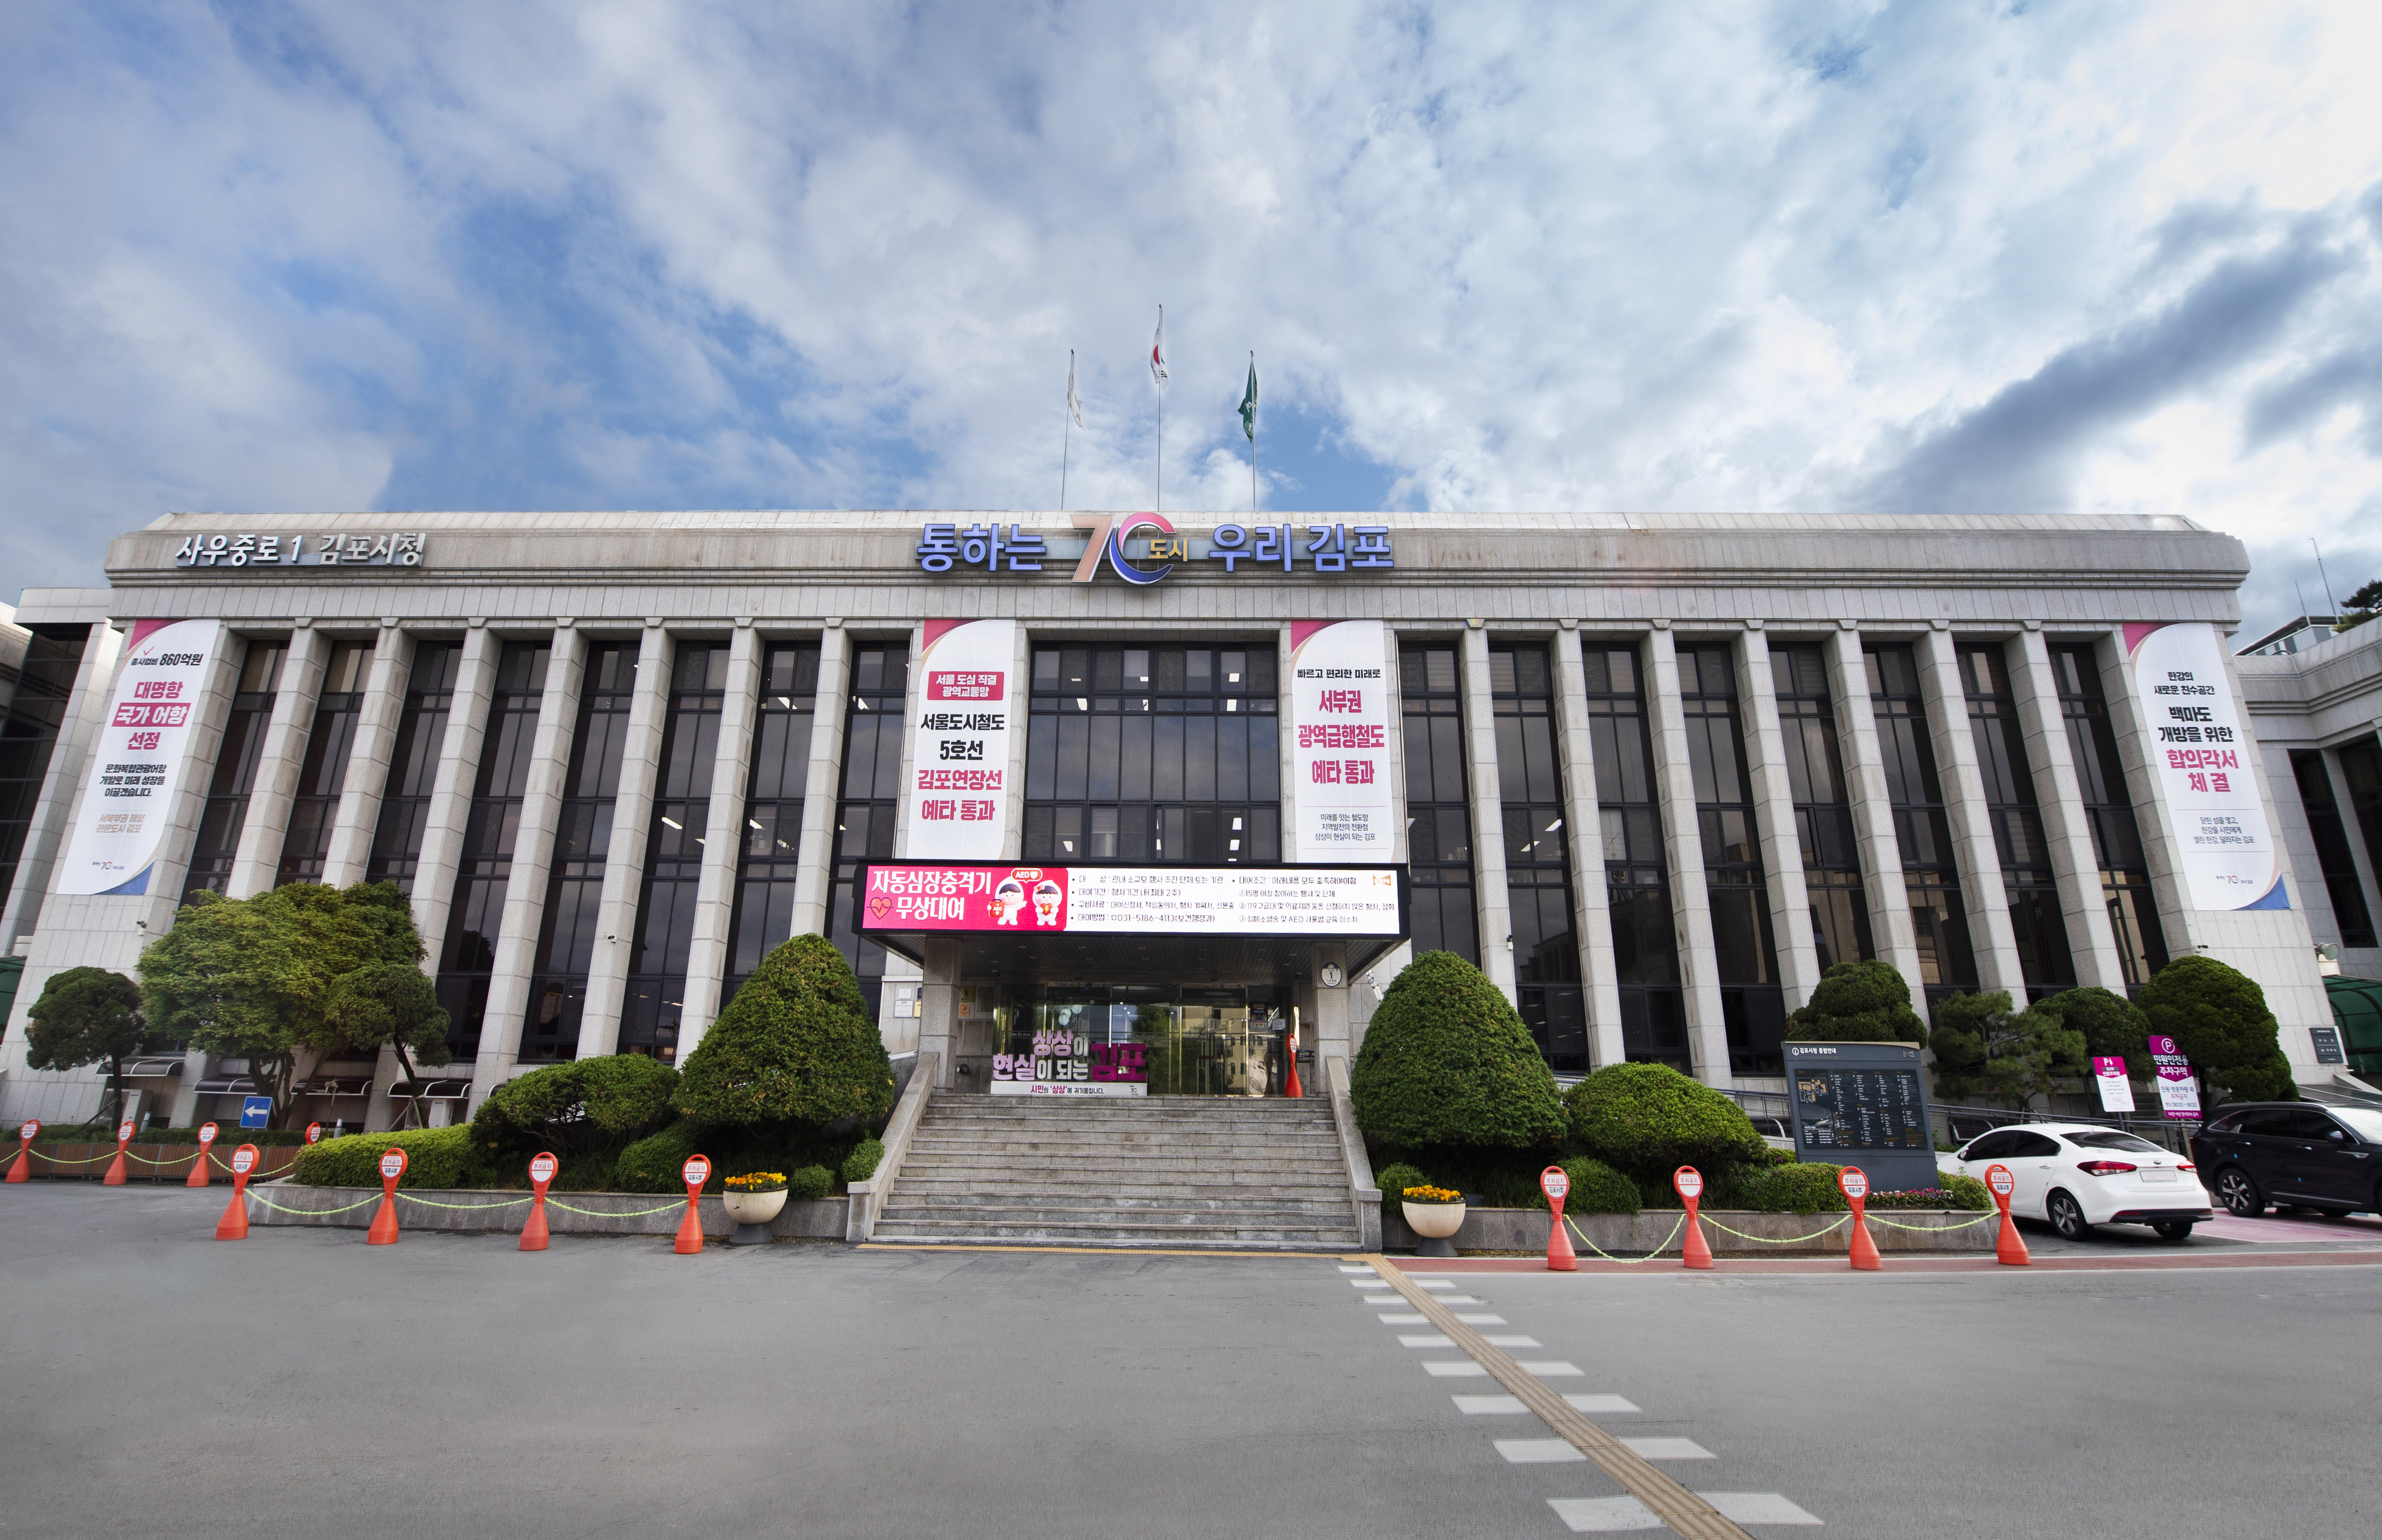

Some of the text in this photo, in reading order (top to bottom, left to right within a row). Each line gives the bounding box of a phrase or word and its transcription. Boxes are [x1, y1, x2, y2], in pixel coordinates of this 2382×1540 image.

[175, 532, 425, 566] 사우중로 1 김포시청
[917, 524, 1047, 572] 통하는
[1148, 539, 1188, 562] 도시
[1209, 524, 1292, 572] 우리
[1308, 524, 1394, 572] 김포
[159, 653, 203, 665] 860억원
[936, 675, 996, 685] 서울 도심 직결
[1298, 669, 1381, 679] 빠르고 편리한 미래로
[2167, 671, 2194, 681] 한강의
[134, 681, 183, 698] 대명항
[943, 686, 989, 697] 광역교통망
[2154, 685, 2215, 694] 새로운 친수공간
[1319, 690, 1362, 713] 서부권
[117, 706, 187, 724] 국가 어항
[921, 714, 1004, 730] 서울도시철도
[2169, 707, 2213, 722] 백마도
[128, 732, 161, 750] 선정
[1298, 725, 1385, 748] 광역급행철도
[2158, 726, 2234, 742] 개방을 위한
[940, 740, 983, 760] 5호선
[2166, 749, 2239, 769] 합의각서
[105, 764, 166, 773] 문화복합관광어항
[1311, 760, 1374, 784] 예타 통과
[100, 776, 165, 785] 개발로 미래 성장을
[918, 770, 1002, 790] 김포연장선
[105, 788, 152, 797] 이끌겠습니다.
[99, 814, 145, 823] 서북부권 해양
[922, 800, 995, 821] 예타 통과
[96, 825, 142, 833] 관문도시 김포
[871, 871, 991, 894] 자동심장충격기
[896, 897, 964, 920] 무상대여
[1033, 1030, 1088, 1056] 상상이
[993, 1043, 1147, 1081] 현실이 되는 김포
[2153, 1055, 2189, 1066] 민원인전용
[2160, 1067, 2188, 1077] 주차구역
[1031, 1085, 1048, 1093] 시민의
